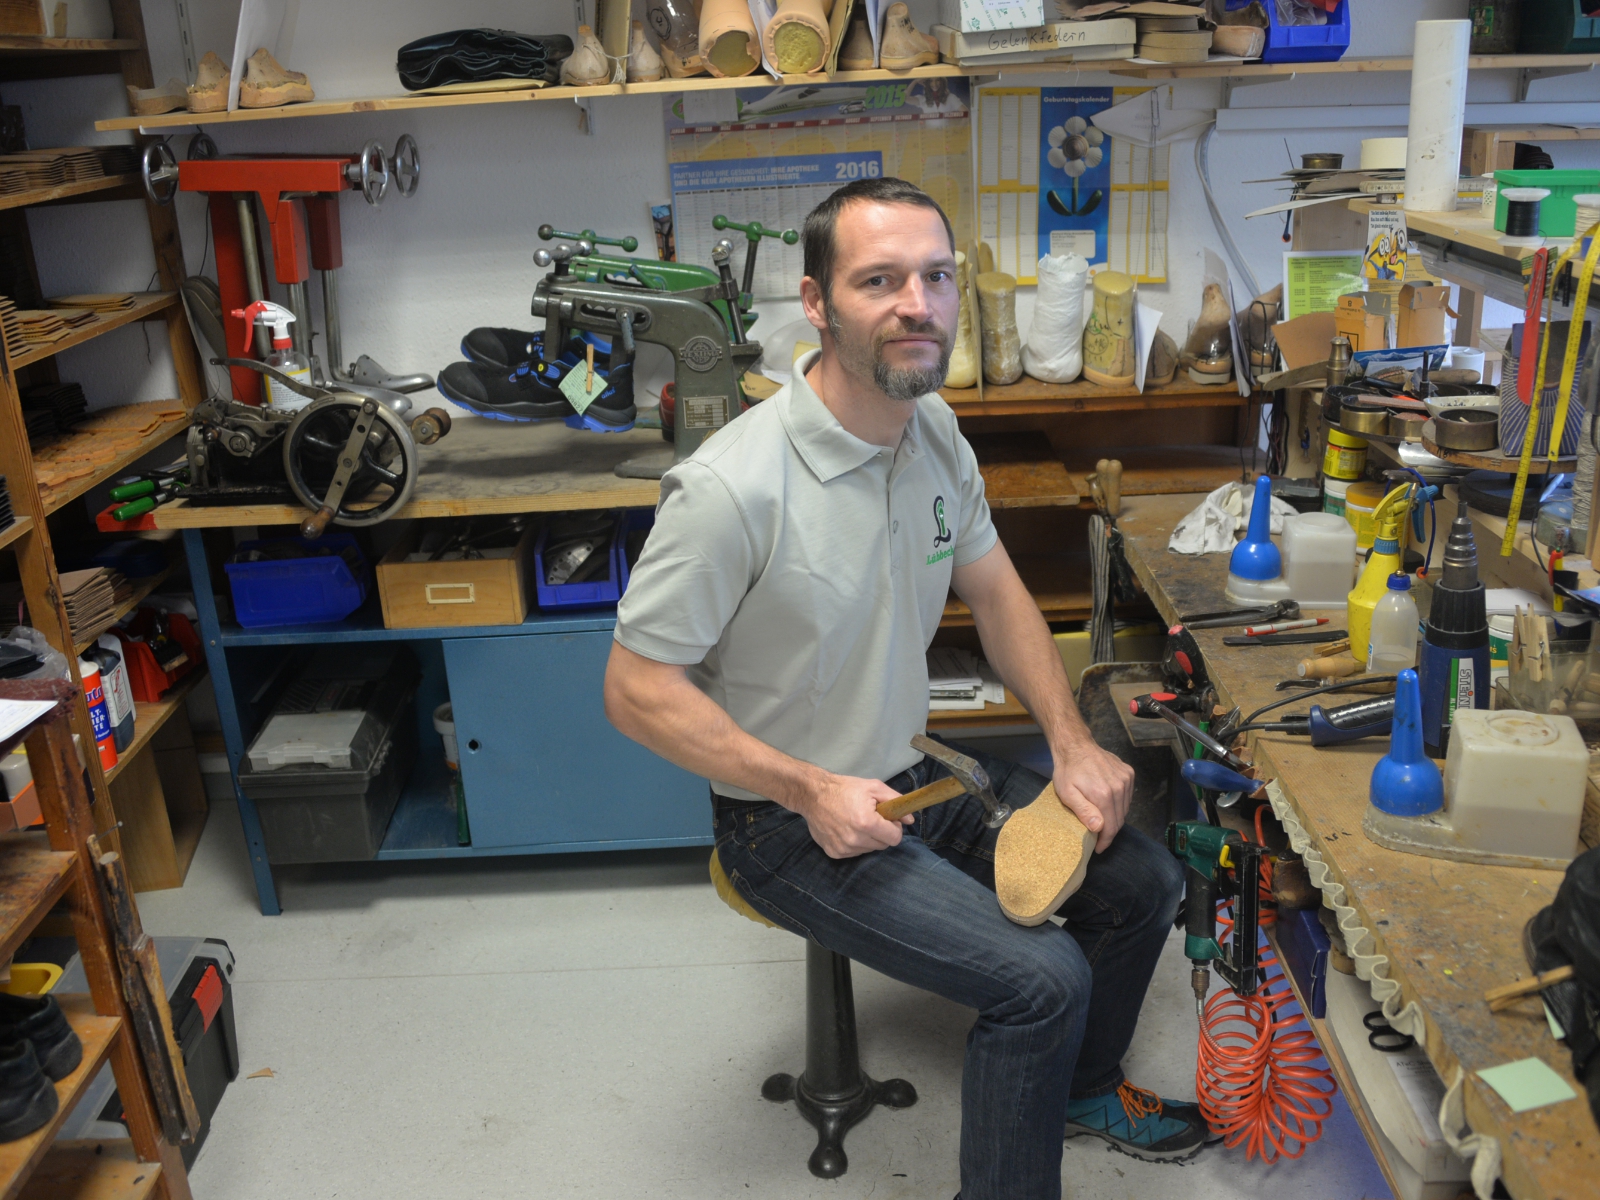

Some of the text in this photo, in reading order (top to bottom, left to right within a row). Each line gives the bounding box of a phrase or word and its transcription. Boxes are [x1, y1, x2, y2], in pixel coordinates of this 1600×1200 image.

[865, 84, 907, 109] 2015
[1043, 96, 1110, 104] Geburtstagskalender
[674, 171, 701, 179] PARTNER
[701, 169, 714, 177] FÜR
[715, 169, 729, 177] IHRE
[787, 164, 820, 173] APOTHEKE
[835, 160, 879, 179] 2016
[674, 172, 800, 187] UND DIE NEUE APOTHEKEN ILLUSTRIERTE
